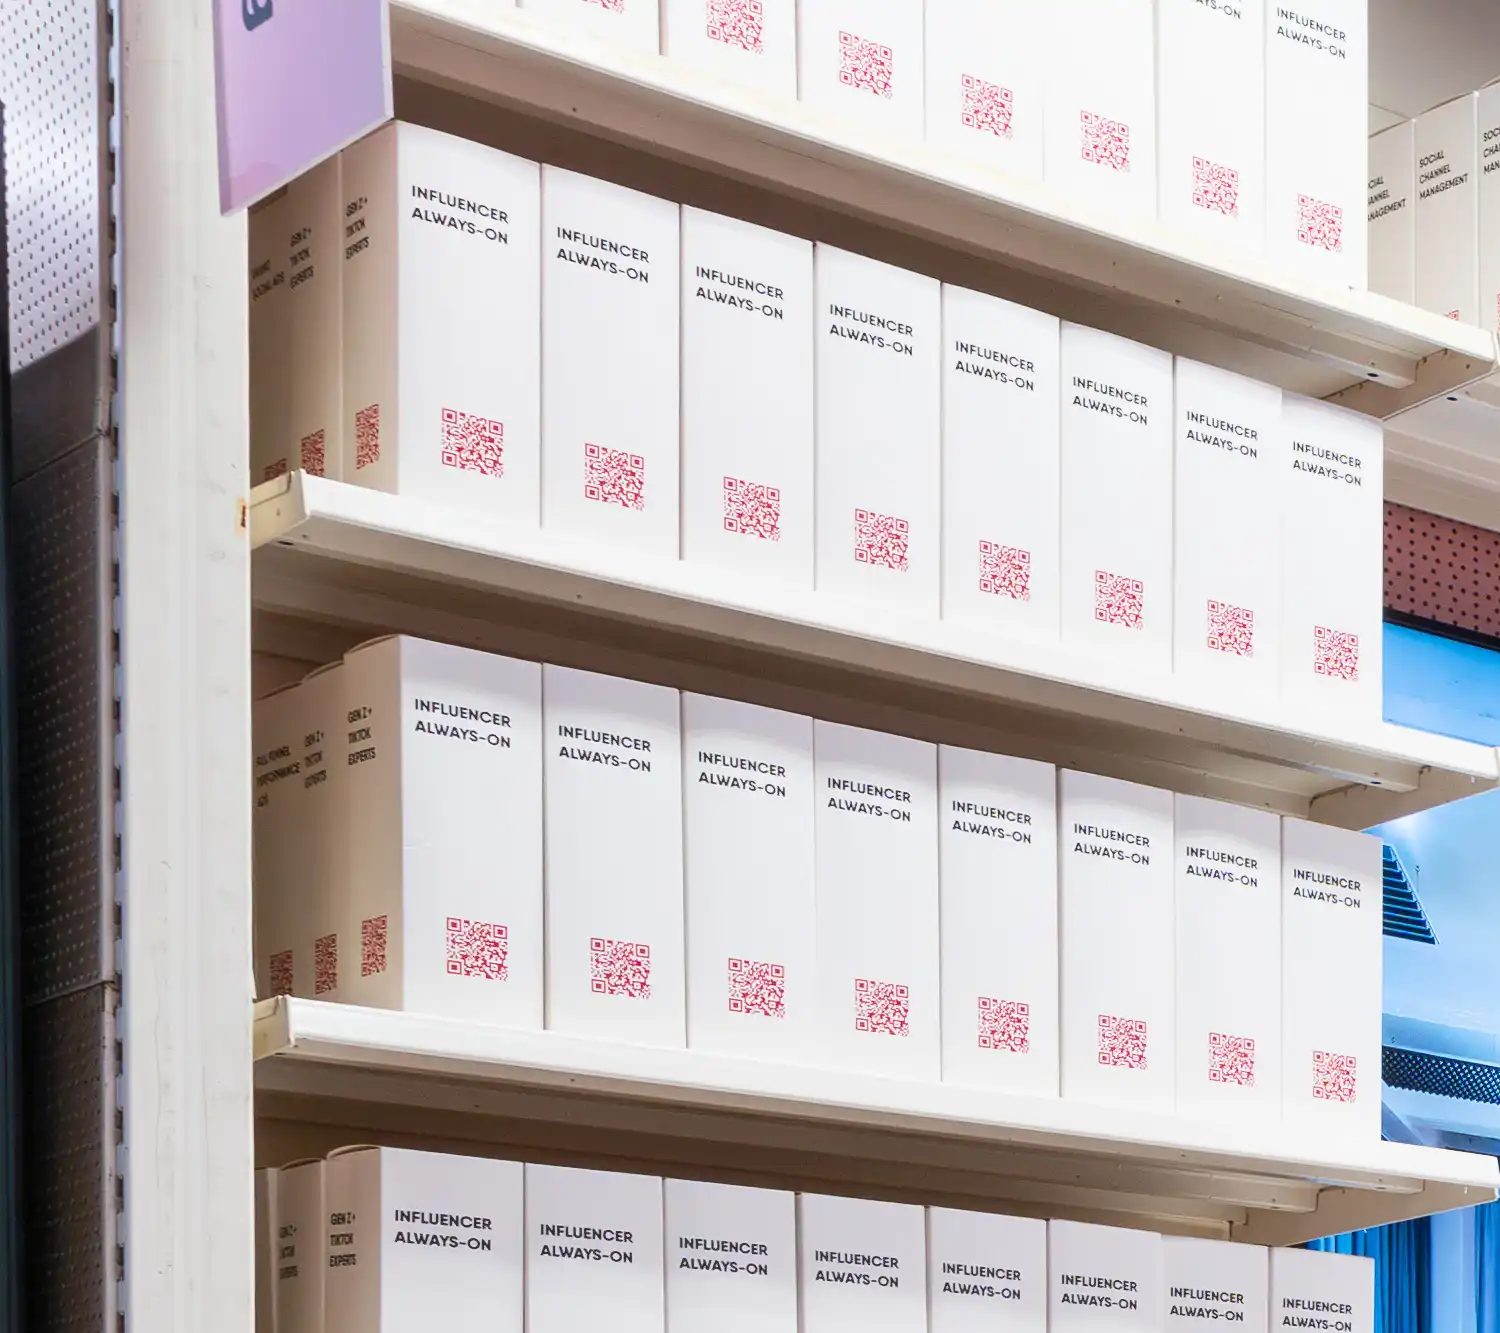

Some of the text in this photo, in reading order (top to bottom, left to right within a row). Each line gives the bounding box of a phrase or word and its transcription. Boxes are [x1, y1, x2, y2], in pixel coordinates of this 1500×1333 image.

[1277, 7, 1346, 40] INFLUENCER
[1276, 25, 1346, 59] ALWAYS-ON
[412, 185, 509, 225] INFLUENCER
[411, 207, 508, 245] ALWAYS-ON
[696, 265, 784, 300] INFLUENCER
[696, 286, 783, 320] ALWAYS-ON
[955, 340, 1035, 373] INFLUENCER
[955, 360, 1034, 391] ALWAYS-ON
[1292, 441, 1362, 469] INFLUENCER
[1292, 459, 1361, 486] ALWAYS-ON
[414, 698, 511, 728] INFLUENCER
[414, 720, 511, 749] ALWAYS-ON
[698, 751, 786, 778] INFLUENCER
[698, 771, 786, 798] ALWAYS-ON
[952, 800, 1032, 826] INFLUENCER
[952, 820, 1031, 844] ALWAYS-ON
[1186, 846, 1258, 870] INFLUENCER
[1186, 864, 1258, 888] ALWAYS-ON
[394, 1209, 492, 1231] INFLUENCER
[394, 1231, 492, 1251] ALWAYS-ON
[679, 1237, 769, 1256] INFLUENCER
[679, 1257, 768, 1276] ALWAYS-ON
[942, 1262, 1021, 1281] INFLUENCER
[942, 1281, 1021, 1300] ALWAYS-ON
[1282, 1297, 1352, 1315] INFLUENCER
[1282, 1315, 1352, 1333] ALWAYS-ON
